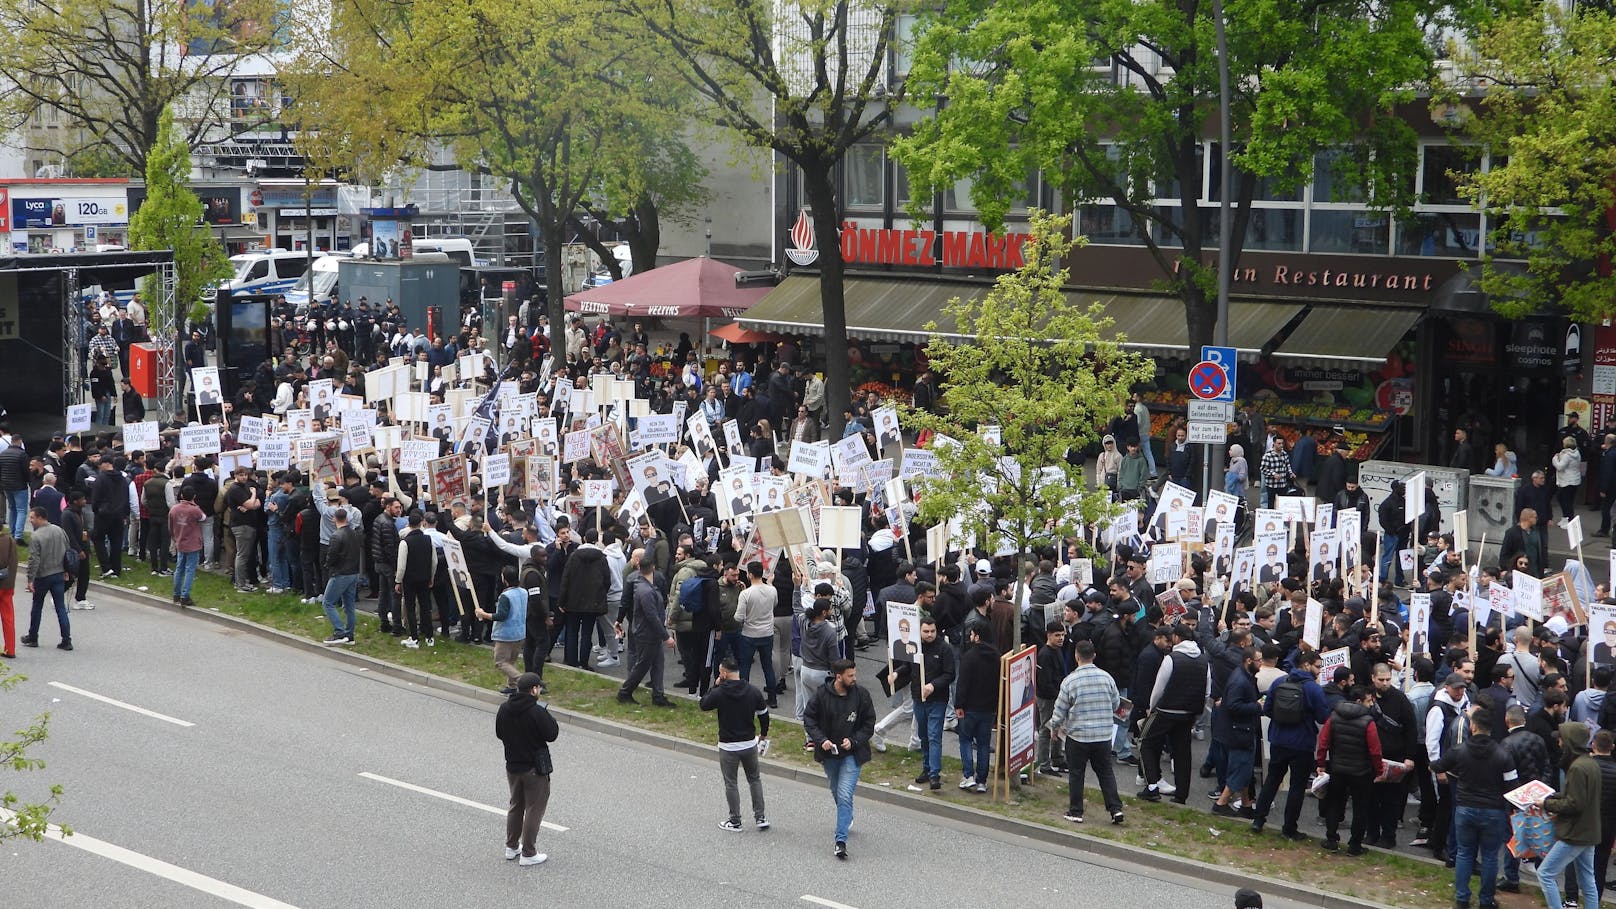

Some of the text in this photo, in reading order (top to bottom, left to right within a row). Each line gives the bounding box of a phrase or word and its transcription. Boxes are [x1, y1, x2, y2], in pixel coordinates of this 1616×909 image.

[25, 201, 45, 210] Lyca
[841, 221, 937, 266] ÖNMEZ
[1273, 265, 1433, 291] Restaurant
[580, 301, 611, 313] VELTINS
[648, 305, 680, 316] VELTINS
[1207, 350, 1222, 364] P
[1321, 652, 1345, 668] DISKURS
